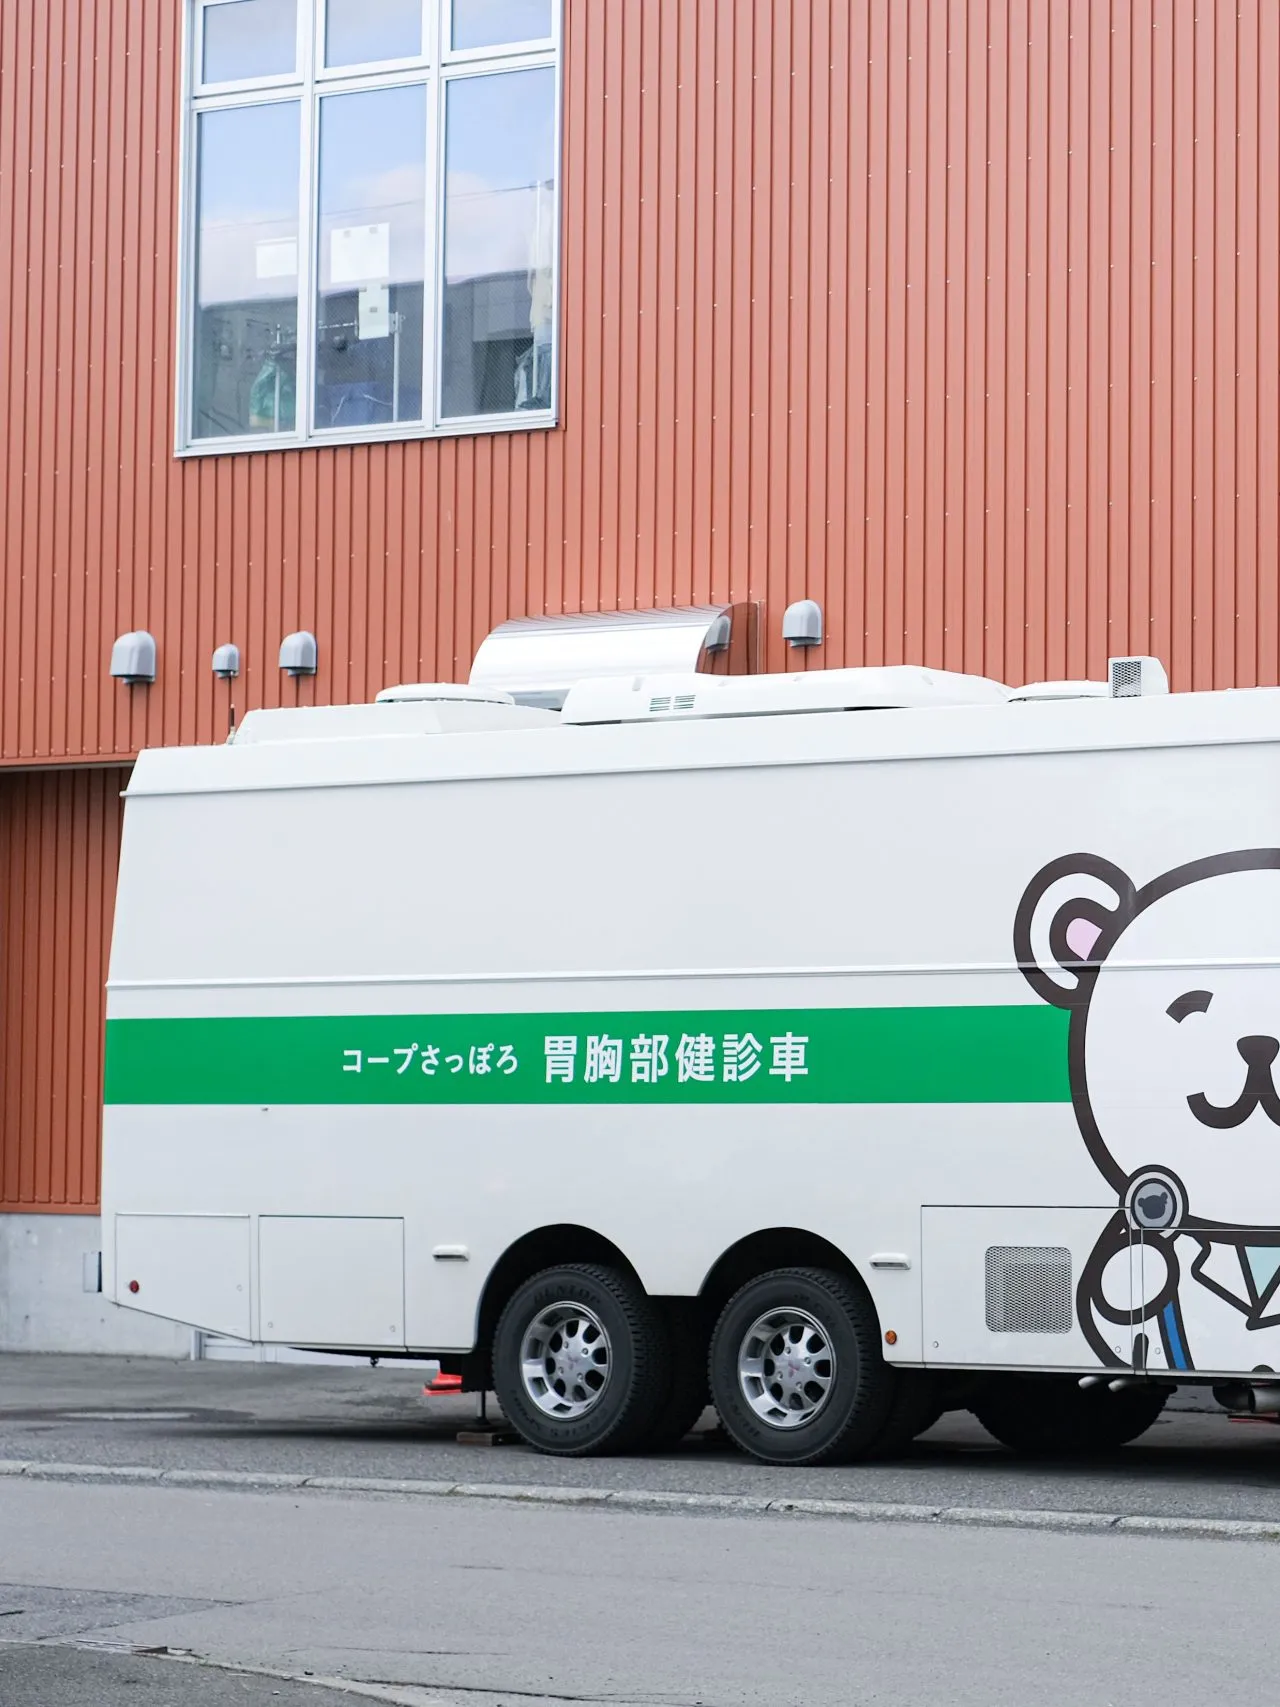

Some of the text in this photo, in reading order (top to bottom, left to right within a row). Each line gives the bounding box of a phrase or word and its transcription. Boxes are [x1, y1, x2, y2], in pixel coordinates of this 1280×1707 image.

[341, 1031, 810, 1084] コープさっぽろ 胃胸部健診車
